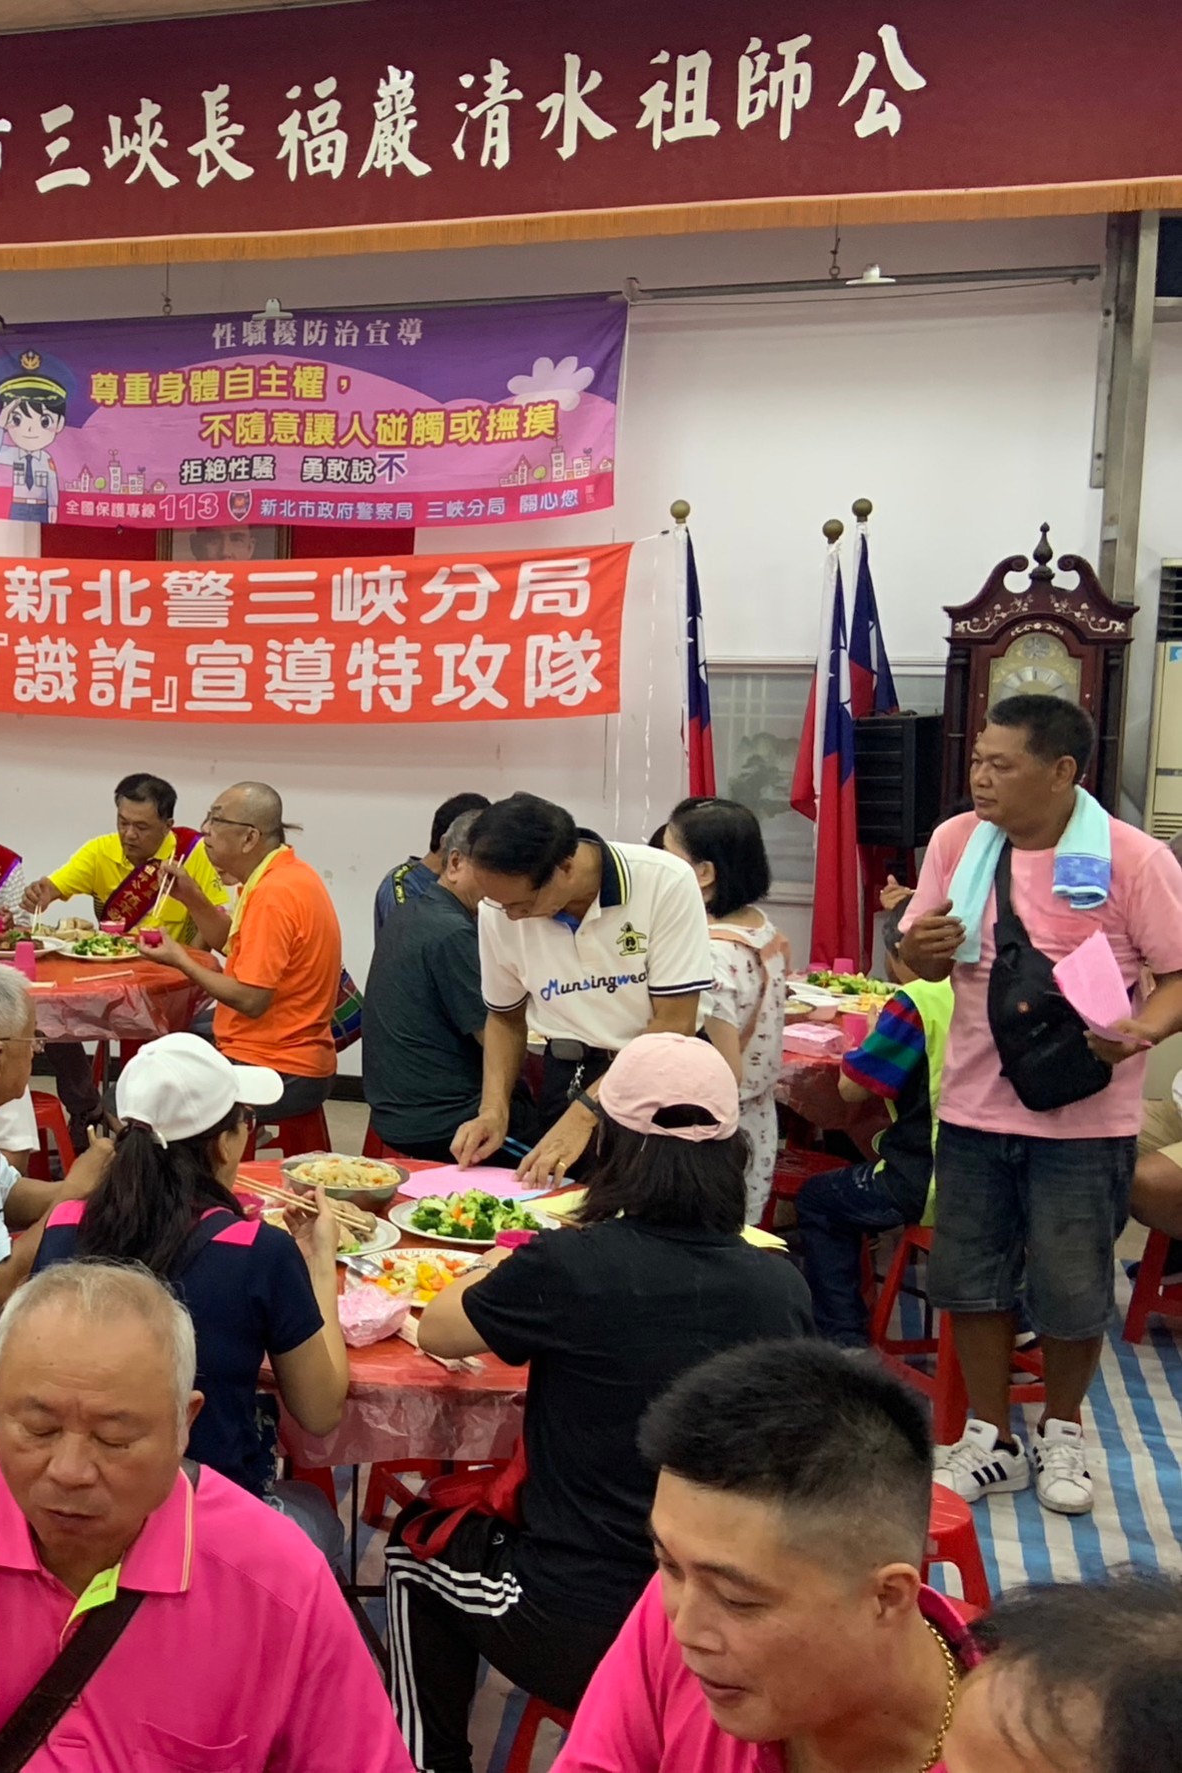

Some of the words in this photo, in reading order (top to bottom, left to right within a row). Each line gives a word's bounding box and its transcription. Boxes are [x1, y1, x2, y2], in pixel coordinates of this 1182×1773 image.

[212, 318, 423, 349] 性騷擾防治宣導
[90, 363, 350, 405] 尊重身體自主權，
[202, 403, 558, 446] 不隨意讓人碰觸或撫摸
[302, 451, 407, 484] 勇敢說不
[260, 499, 414, 521] 新北市政府警察局
[426, 496, 505, 519] 三峽分局
[519, 489, 579, 513] 關心您
[4, 558, 591, 628] 新北警三峽分局
[540, 972, 648, 1001] Munsingwea
